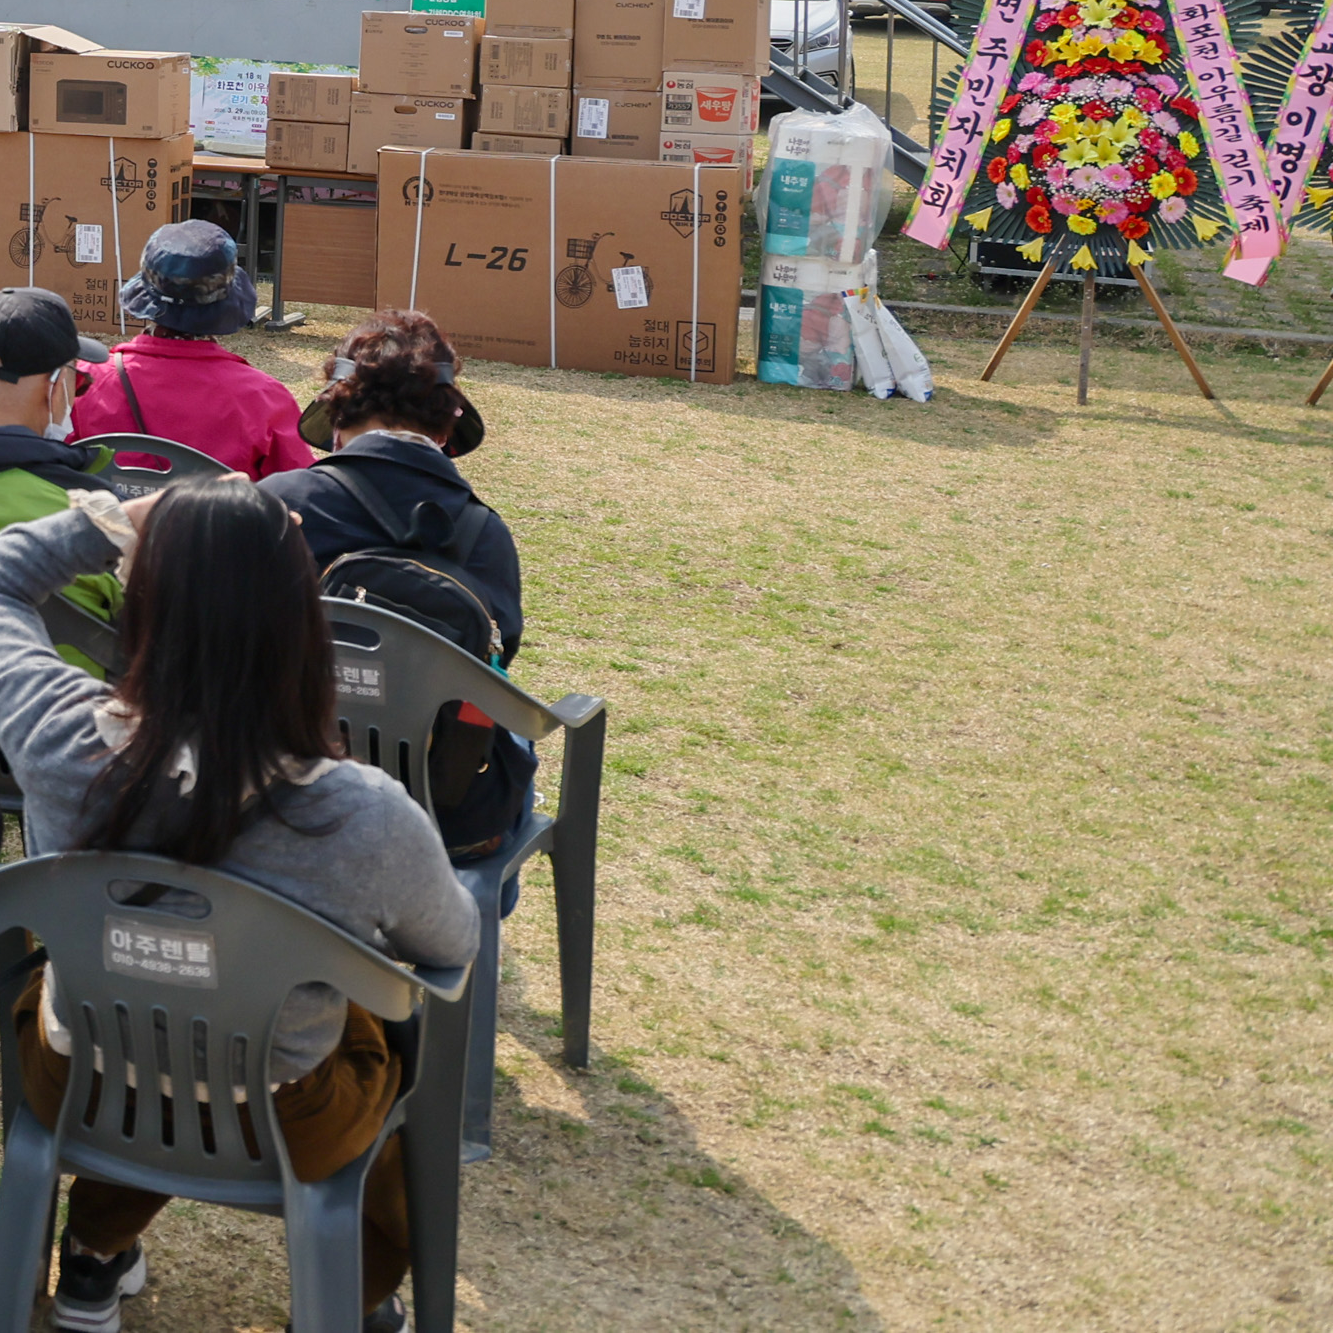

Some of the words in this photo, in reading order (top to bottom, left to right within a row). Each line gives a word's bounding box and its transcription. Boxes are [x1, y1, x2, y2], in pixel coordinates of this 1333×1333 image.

[425, 18, 466, 27] CUCKOO
[1178, 3, 1220, 60] 화포천
[107, 60, 155, 70] CUCKOO
[246, 72, 254, 80] 18
[217, 81, 244, 91] 화포천
[248, 82, 270, 91] 아우
[231, 94, 248, 104] 걷기
[414, 99, 454, 109] CUCKOO
[699, 99, 733, 112] 새우탕
[1198, 67, 1243, 143] 아우름길
[922, 37, 1009, 218] 주민자치회
[674, 142, 691, 150] 농심
[1222, 148, 1257, 187] 걷기
[780, 174, 809, 188] 내추럴
[1234, 195, 1270, 234] 축제
[445, 243, 529, 272] L-26
[85, 278, 108, 291] 절대
[73, 292, 108, 307] 눕히지
[71, 308, 107, 322] 십시오
[769, 302, 797, 315] 내추럴
[643, 319, 670, 334] 절대
[629, 335, 670, 351] 눕히지
[614, 350, 669, 367] 마십시오
[110, 928, 210, 963] 아주렌탈
